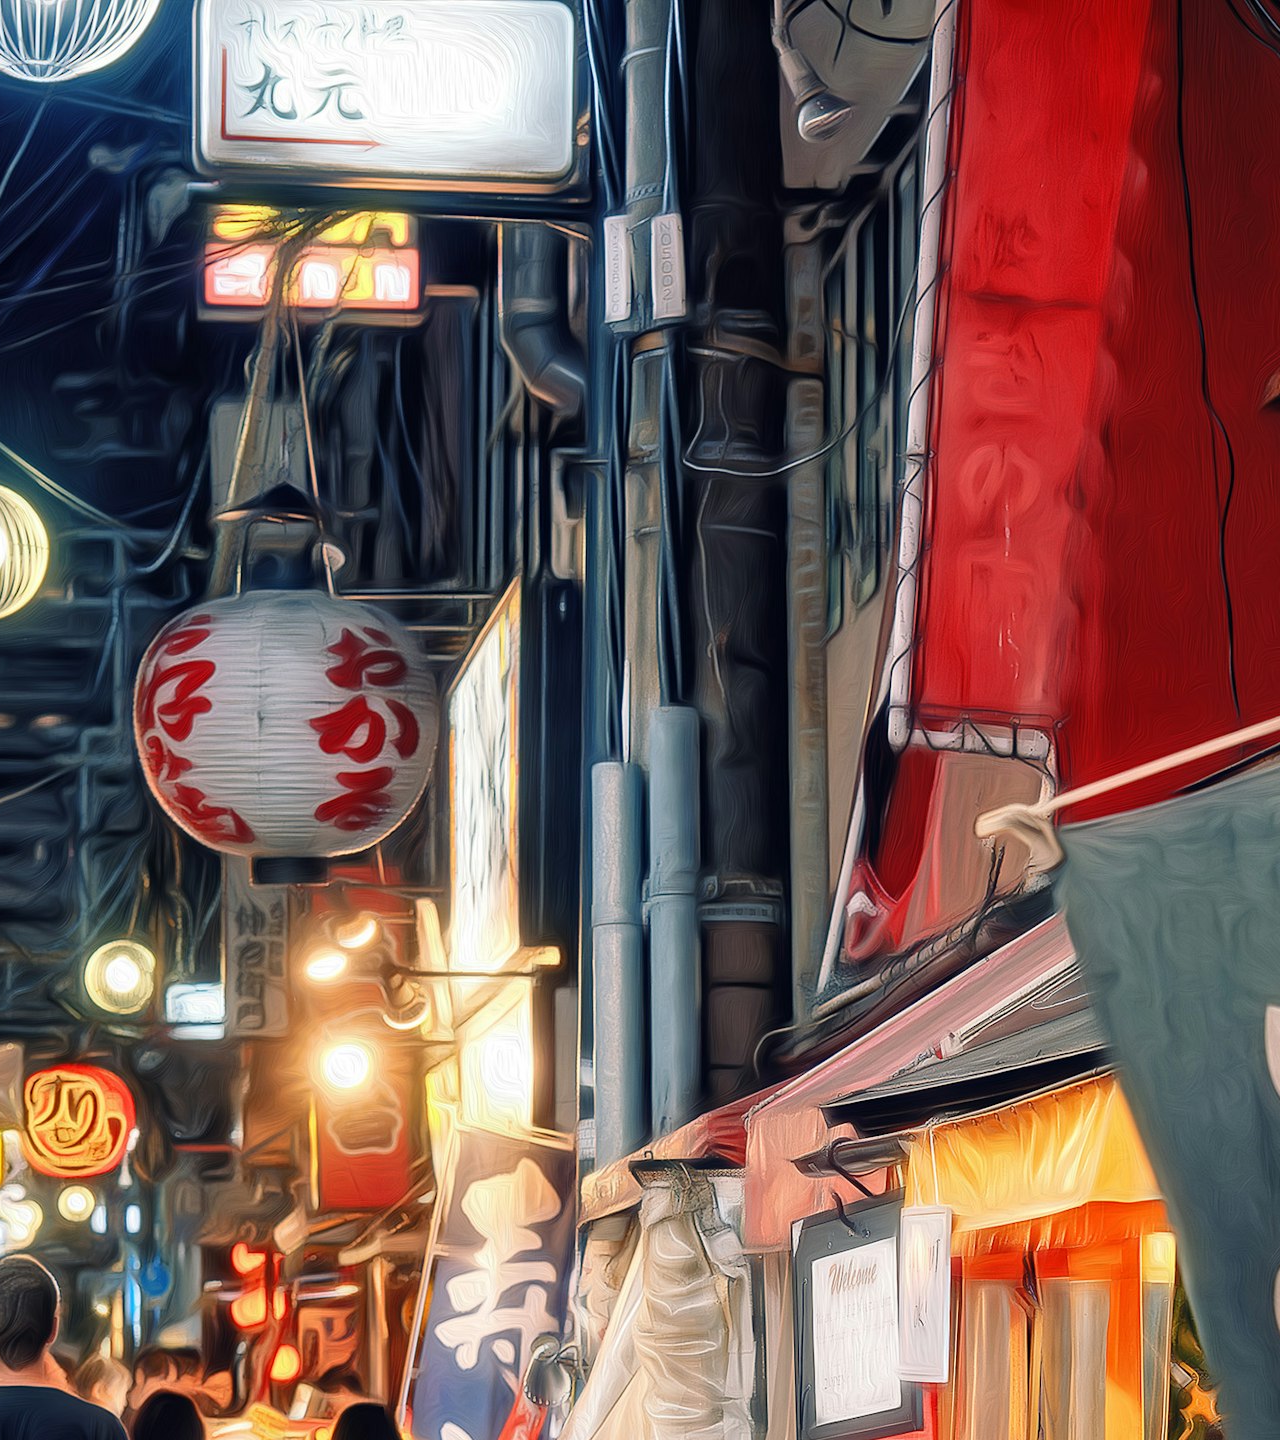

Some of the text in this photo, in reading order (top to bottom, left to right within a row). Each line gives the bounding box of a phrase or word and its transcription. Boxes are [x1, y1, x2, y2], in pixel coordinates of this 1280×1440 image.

[239, 60, 367, 121] 丸元
[308, 627, 421, 831] おかる
[828, 1259, 879, 1296] Welcome
